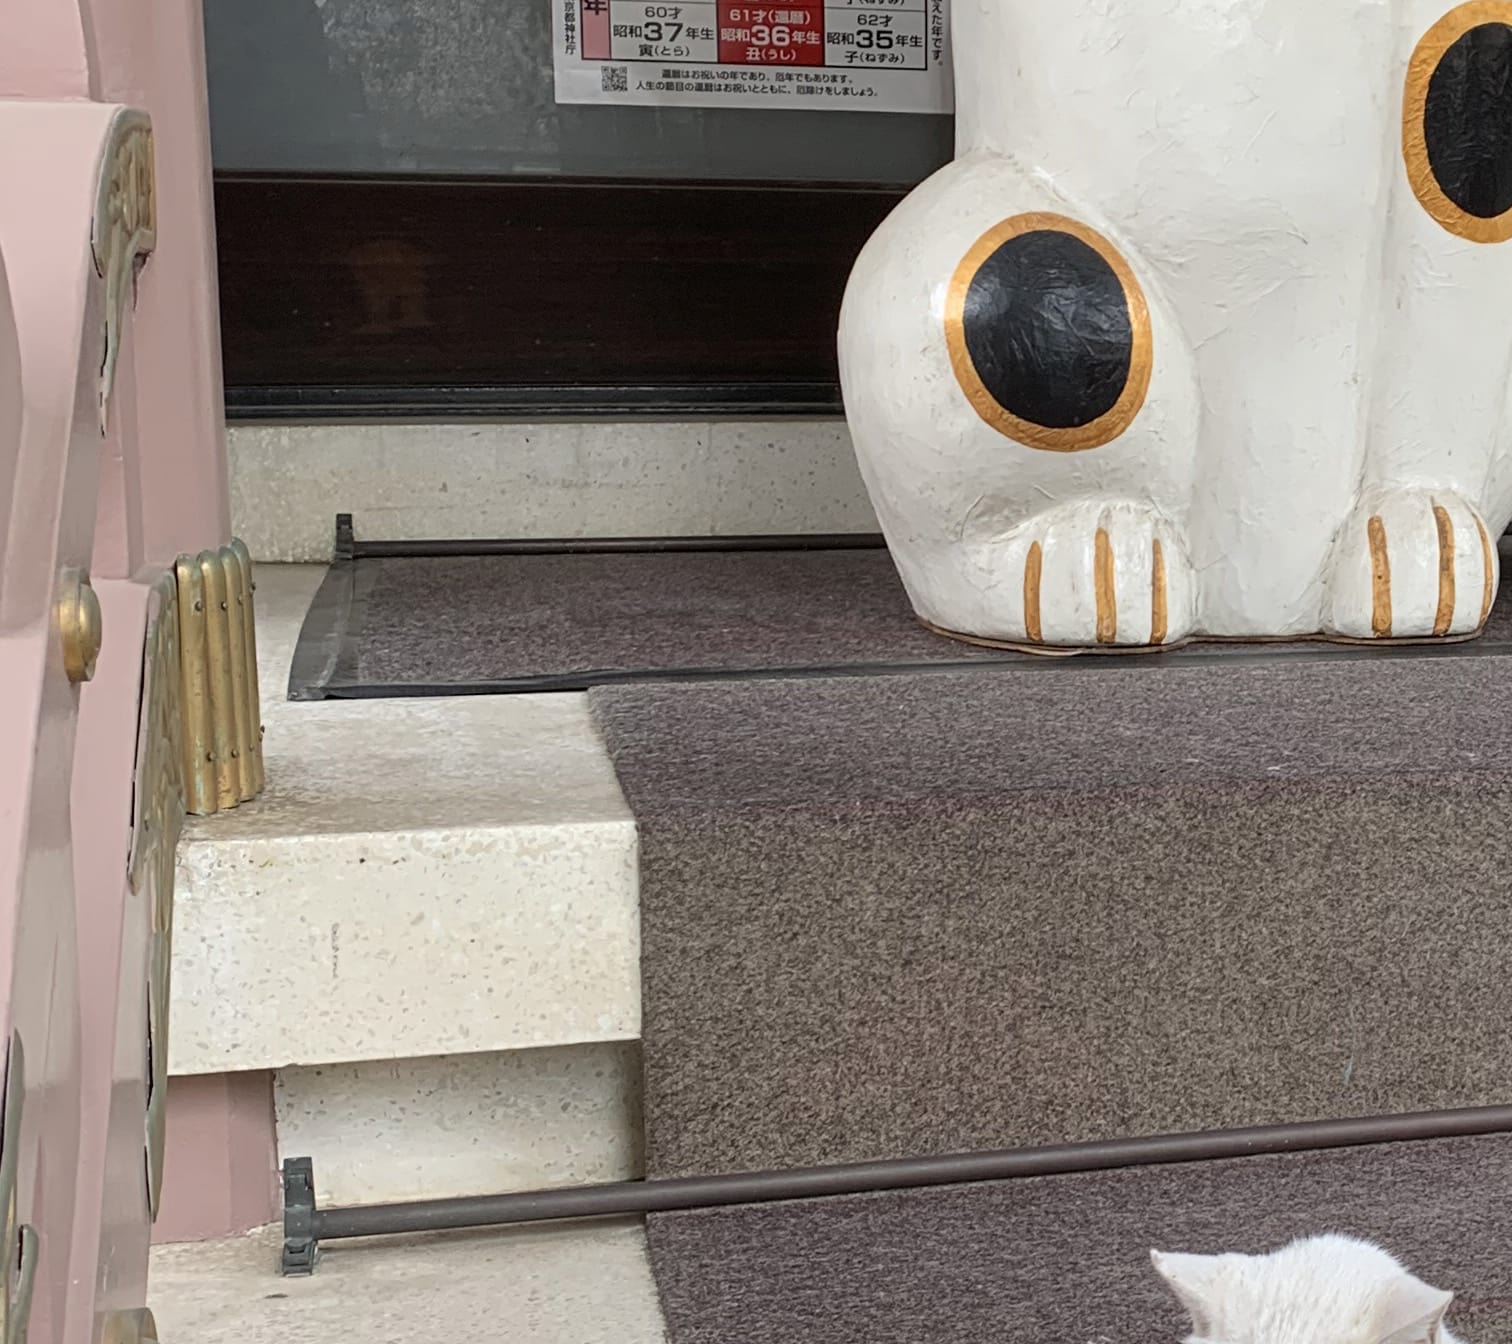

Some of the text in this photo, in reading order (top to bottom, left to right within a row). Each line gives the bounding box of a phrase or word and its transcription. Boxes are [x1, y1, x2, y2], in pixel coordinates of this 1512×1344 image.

[645, 7, 682, 19] 60才
[858, 14, 893, 27] 62才
[613, 22, 714, 42] 昭和37年生
[721, 26, 821, 46] 昭和36年生
[827, 30, 923, 49] 昭和35年生
